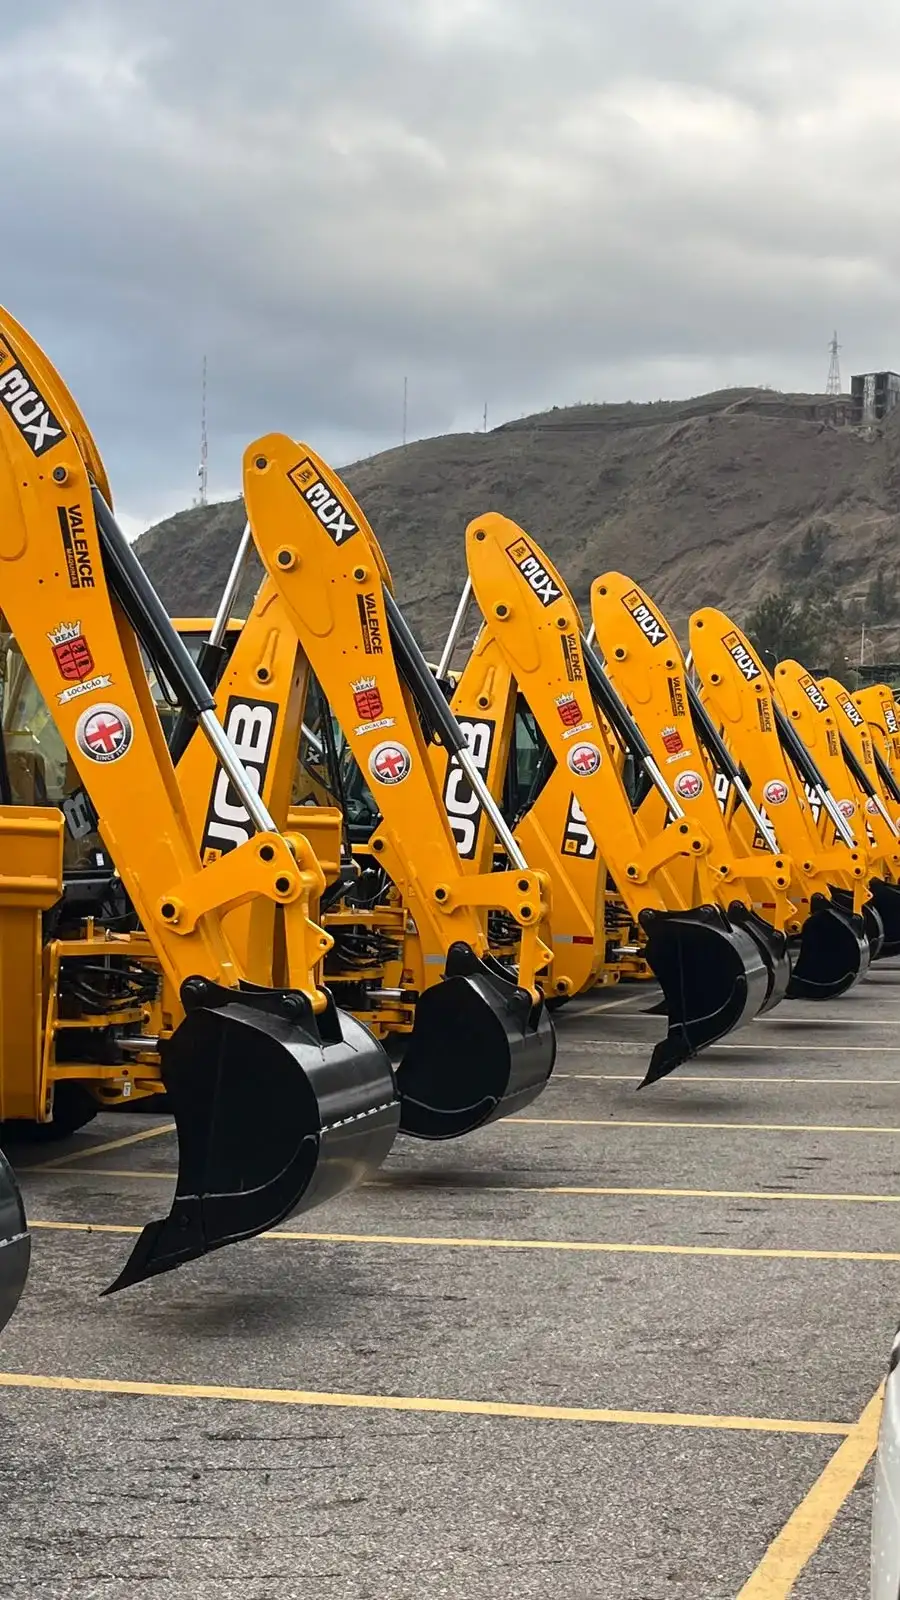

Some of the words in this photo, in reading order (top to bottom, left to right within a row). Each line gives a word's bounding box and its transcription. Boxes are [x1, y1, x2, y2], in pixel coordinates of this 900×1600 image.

[68, 503, 95, 588] VALENCE
[54, 630, 79, 643] REAL
[365, 593, 383, 655] VALENCE
[566, 633, 583, 681] VALENCE
[66, 679, 101, 697] LOCAÇÃO
[356, 683, 373, 692] REAL
[673, 677, 685, 716] VALENCE
[361, 720, 387, 732] LOCAÇÃO
[96, 752, 115, 761] SINCE
[208, 704, 272, 848] JCB
[446, 722, 490, 854] JCB
